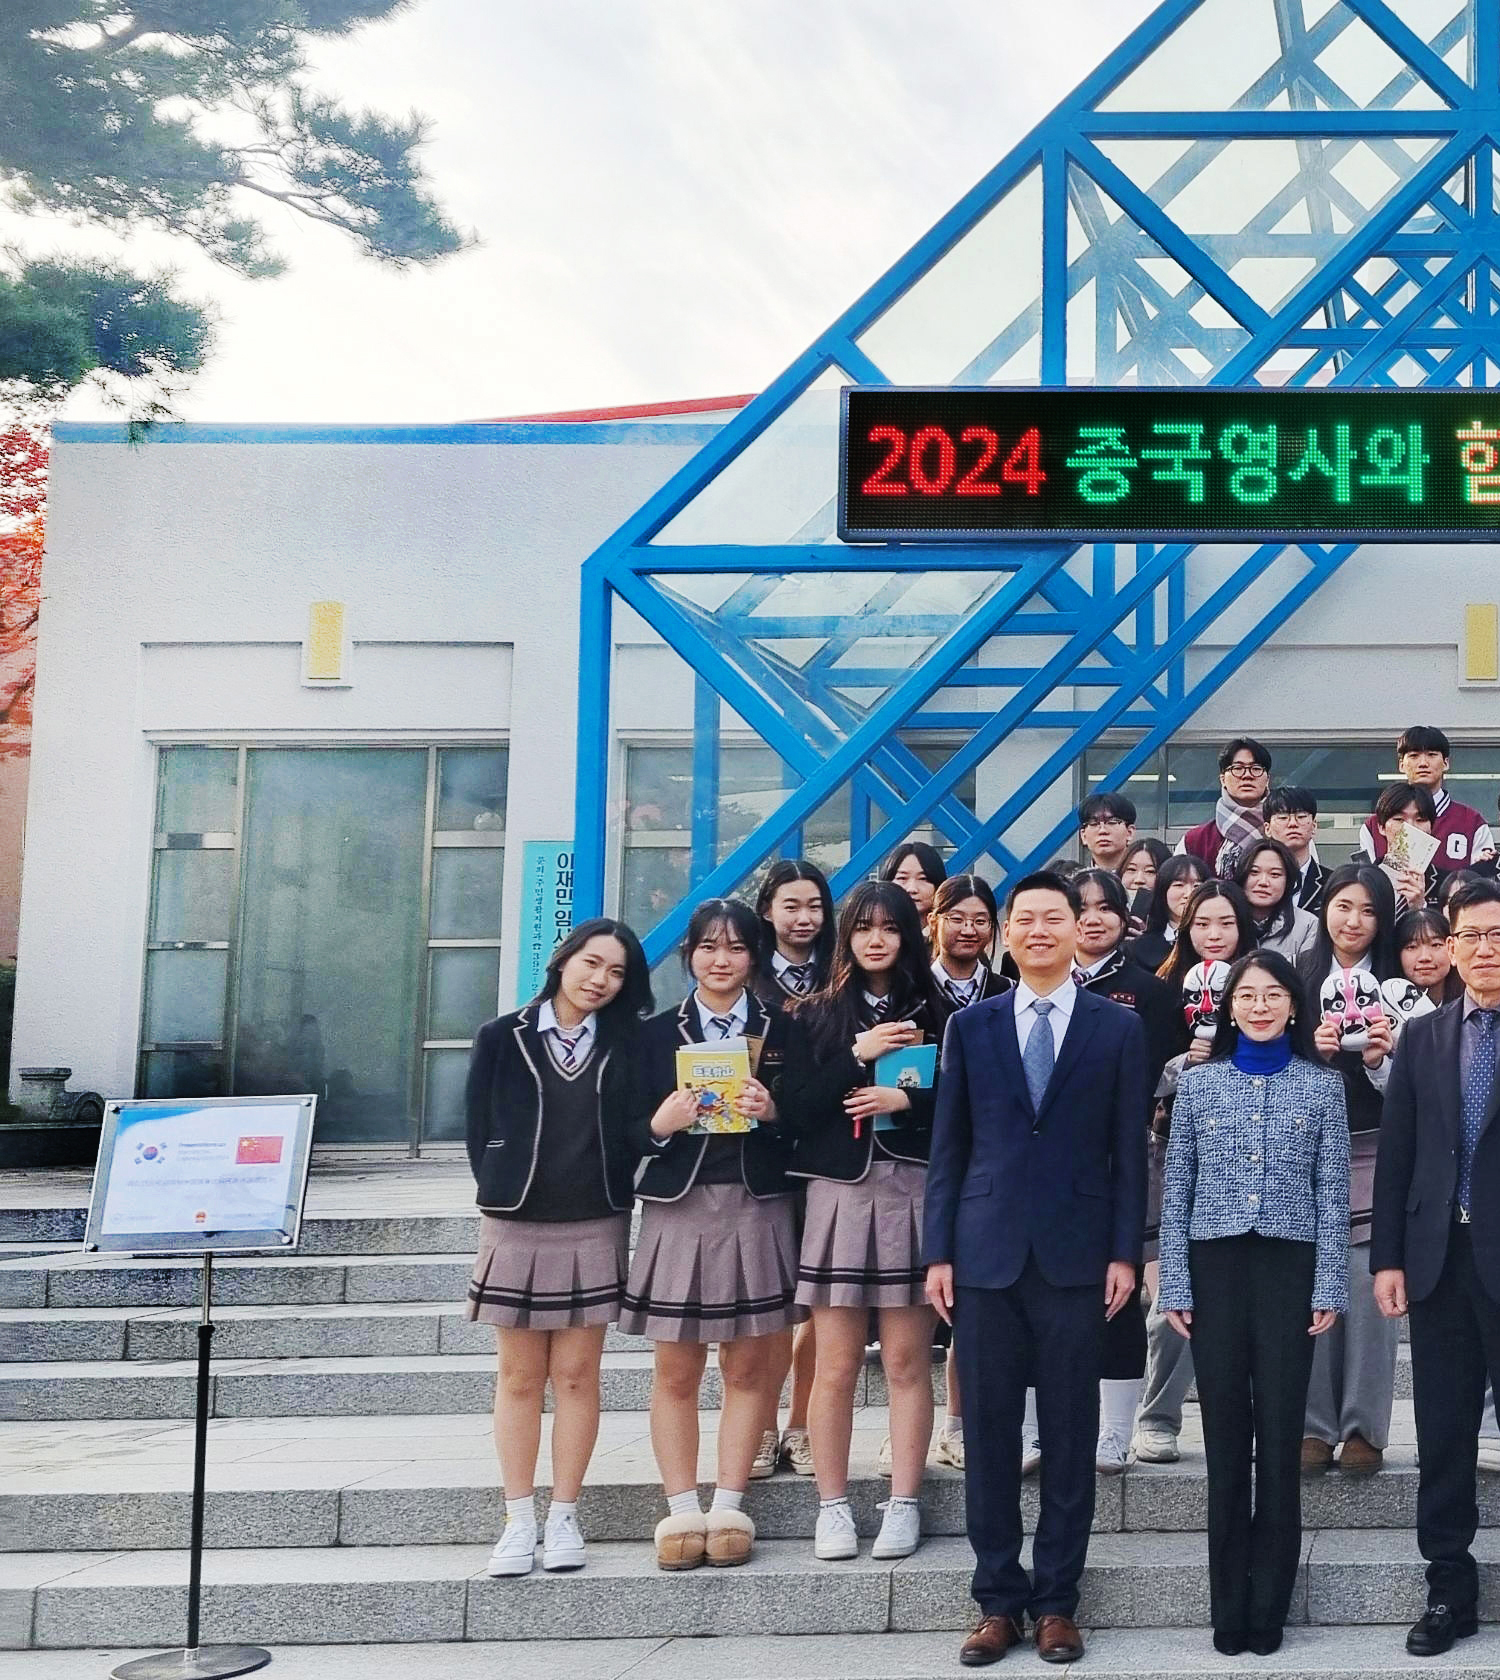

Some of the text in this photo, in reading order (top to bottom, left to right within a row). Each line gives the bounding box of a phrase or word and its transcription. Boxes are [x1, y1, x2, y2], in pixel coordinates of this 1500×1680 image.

[861, 426, 1046, 495] 2024
[1066, 423, 1431, 502] 중국영사와
[556, 853, 574, 905] 이재민
